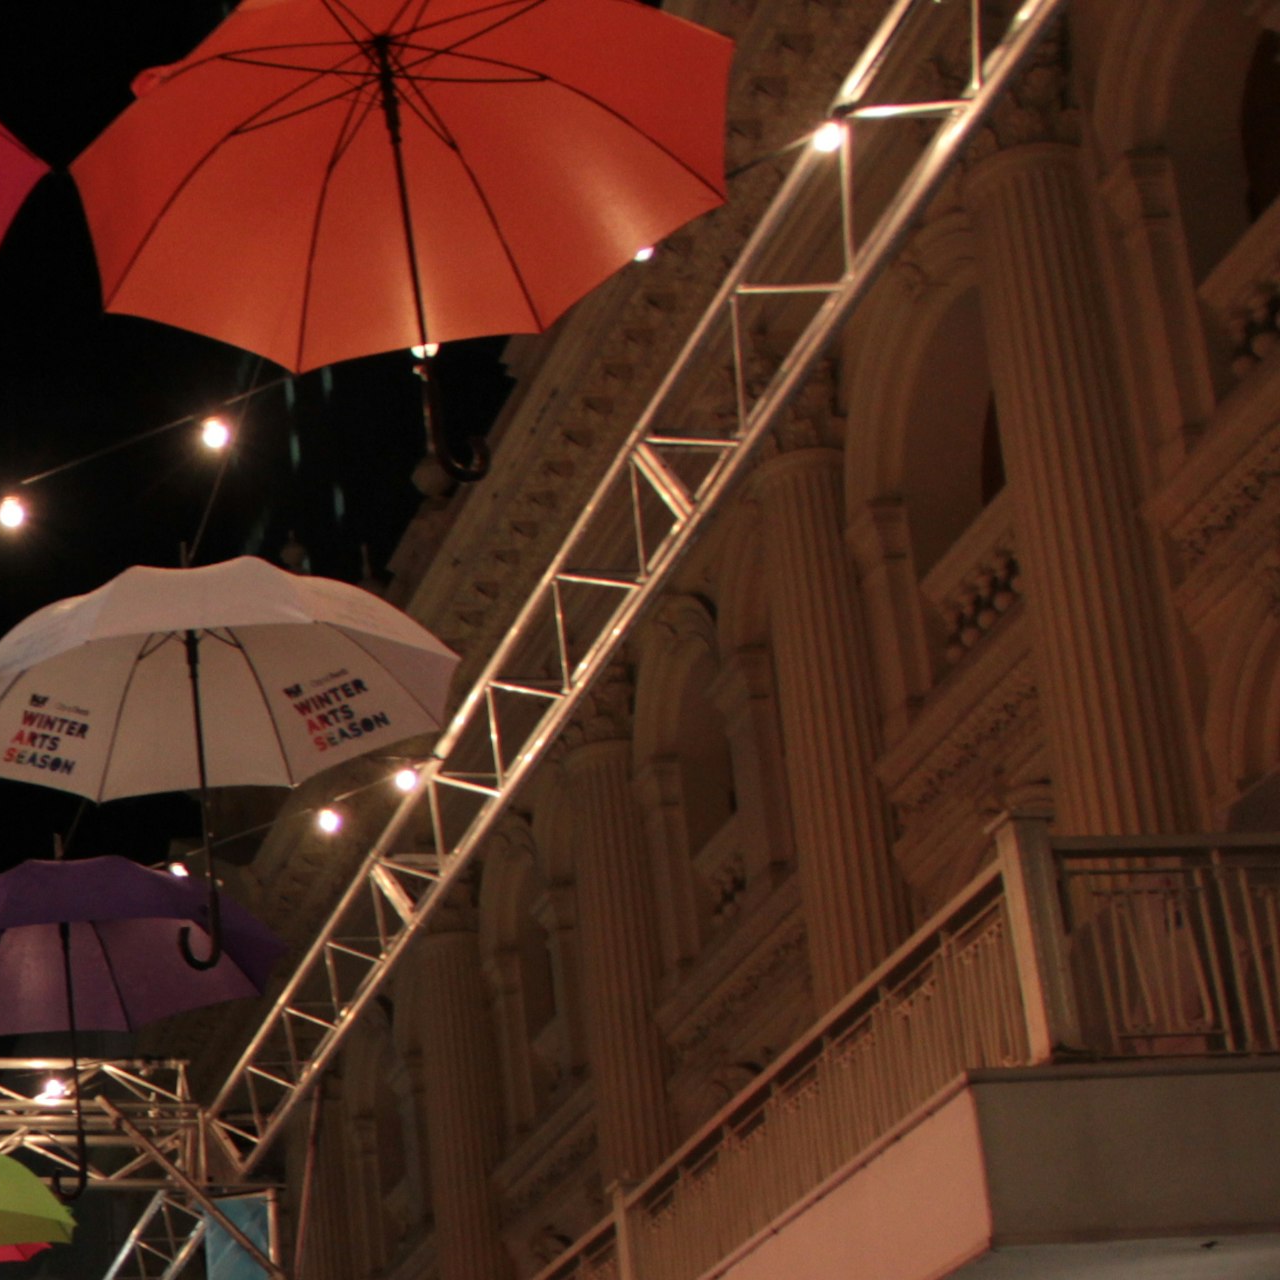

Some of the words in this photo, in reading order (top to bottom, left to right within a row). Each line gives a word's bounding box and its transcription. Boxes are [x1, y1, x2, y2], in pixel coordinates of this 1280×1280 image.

[293, 679, 368, 716] WINTER
[22, 710, 89, 739] WINTER
[307, 704, 354, 735] ARTS
[313, 711, 390, 752] SEASON
[11, 730, 60, 751] ARTS
[3, 747, 75, 775] SEASON
